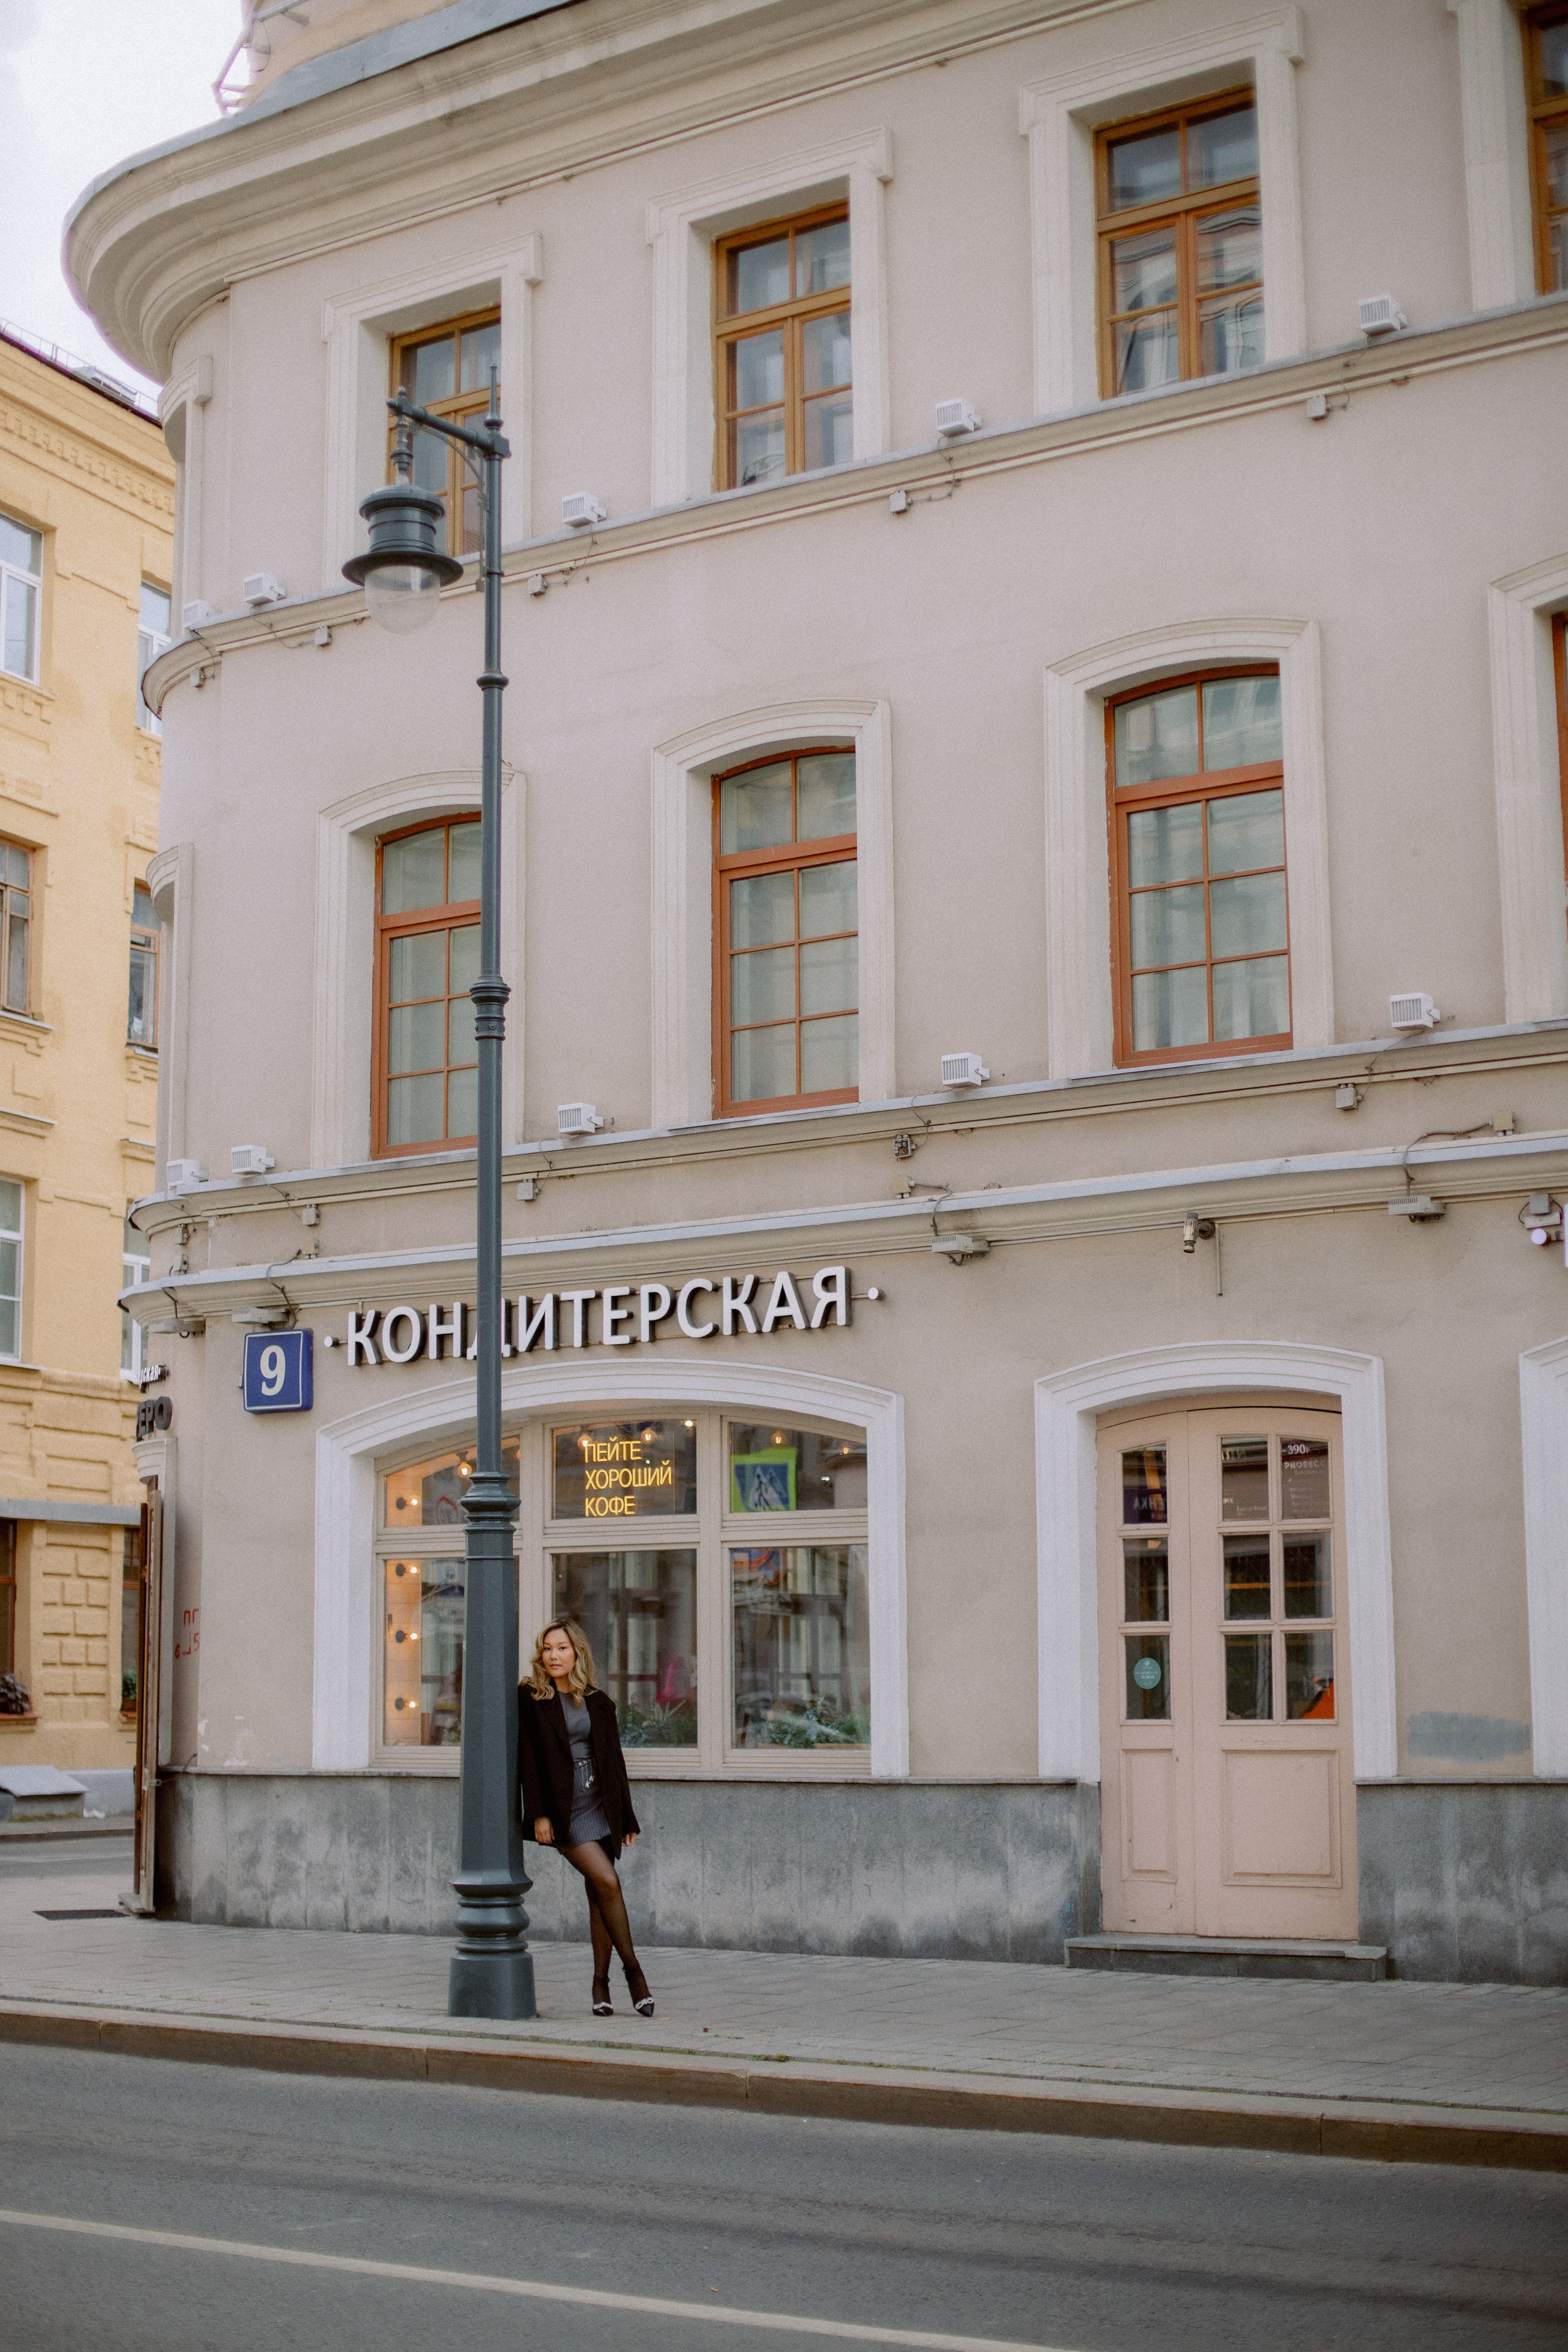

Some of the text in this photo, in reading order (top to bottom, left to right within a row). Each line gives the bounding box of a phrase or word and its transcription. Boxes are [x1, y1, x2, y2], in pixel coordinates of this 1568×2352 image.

[260, 1344, 286, 1396] 9
[584, 1436, 643, 1463] ПЕЙТЕ
[585, 1460, 673, 1490] ХОРОШИЙ
[585, 1495, 636, 1517] КОФЕ
[194, 1632, 200, 1651] 5
